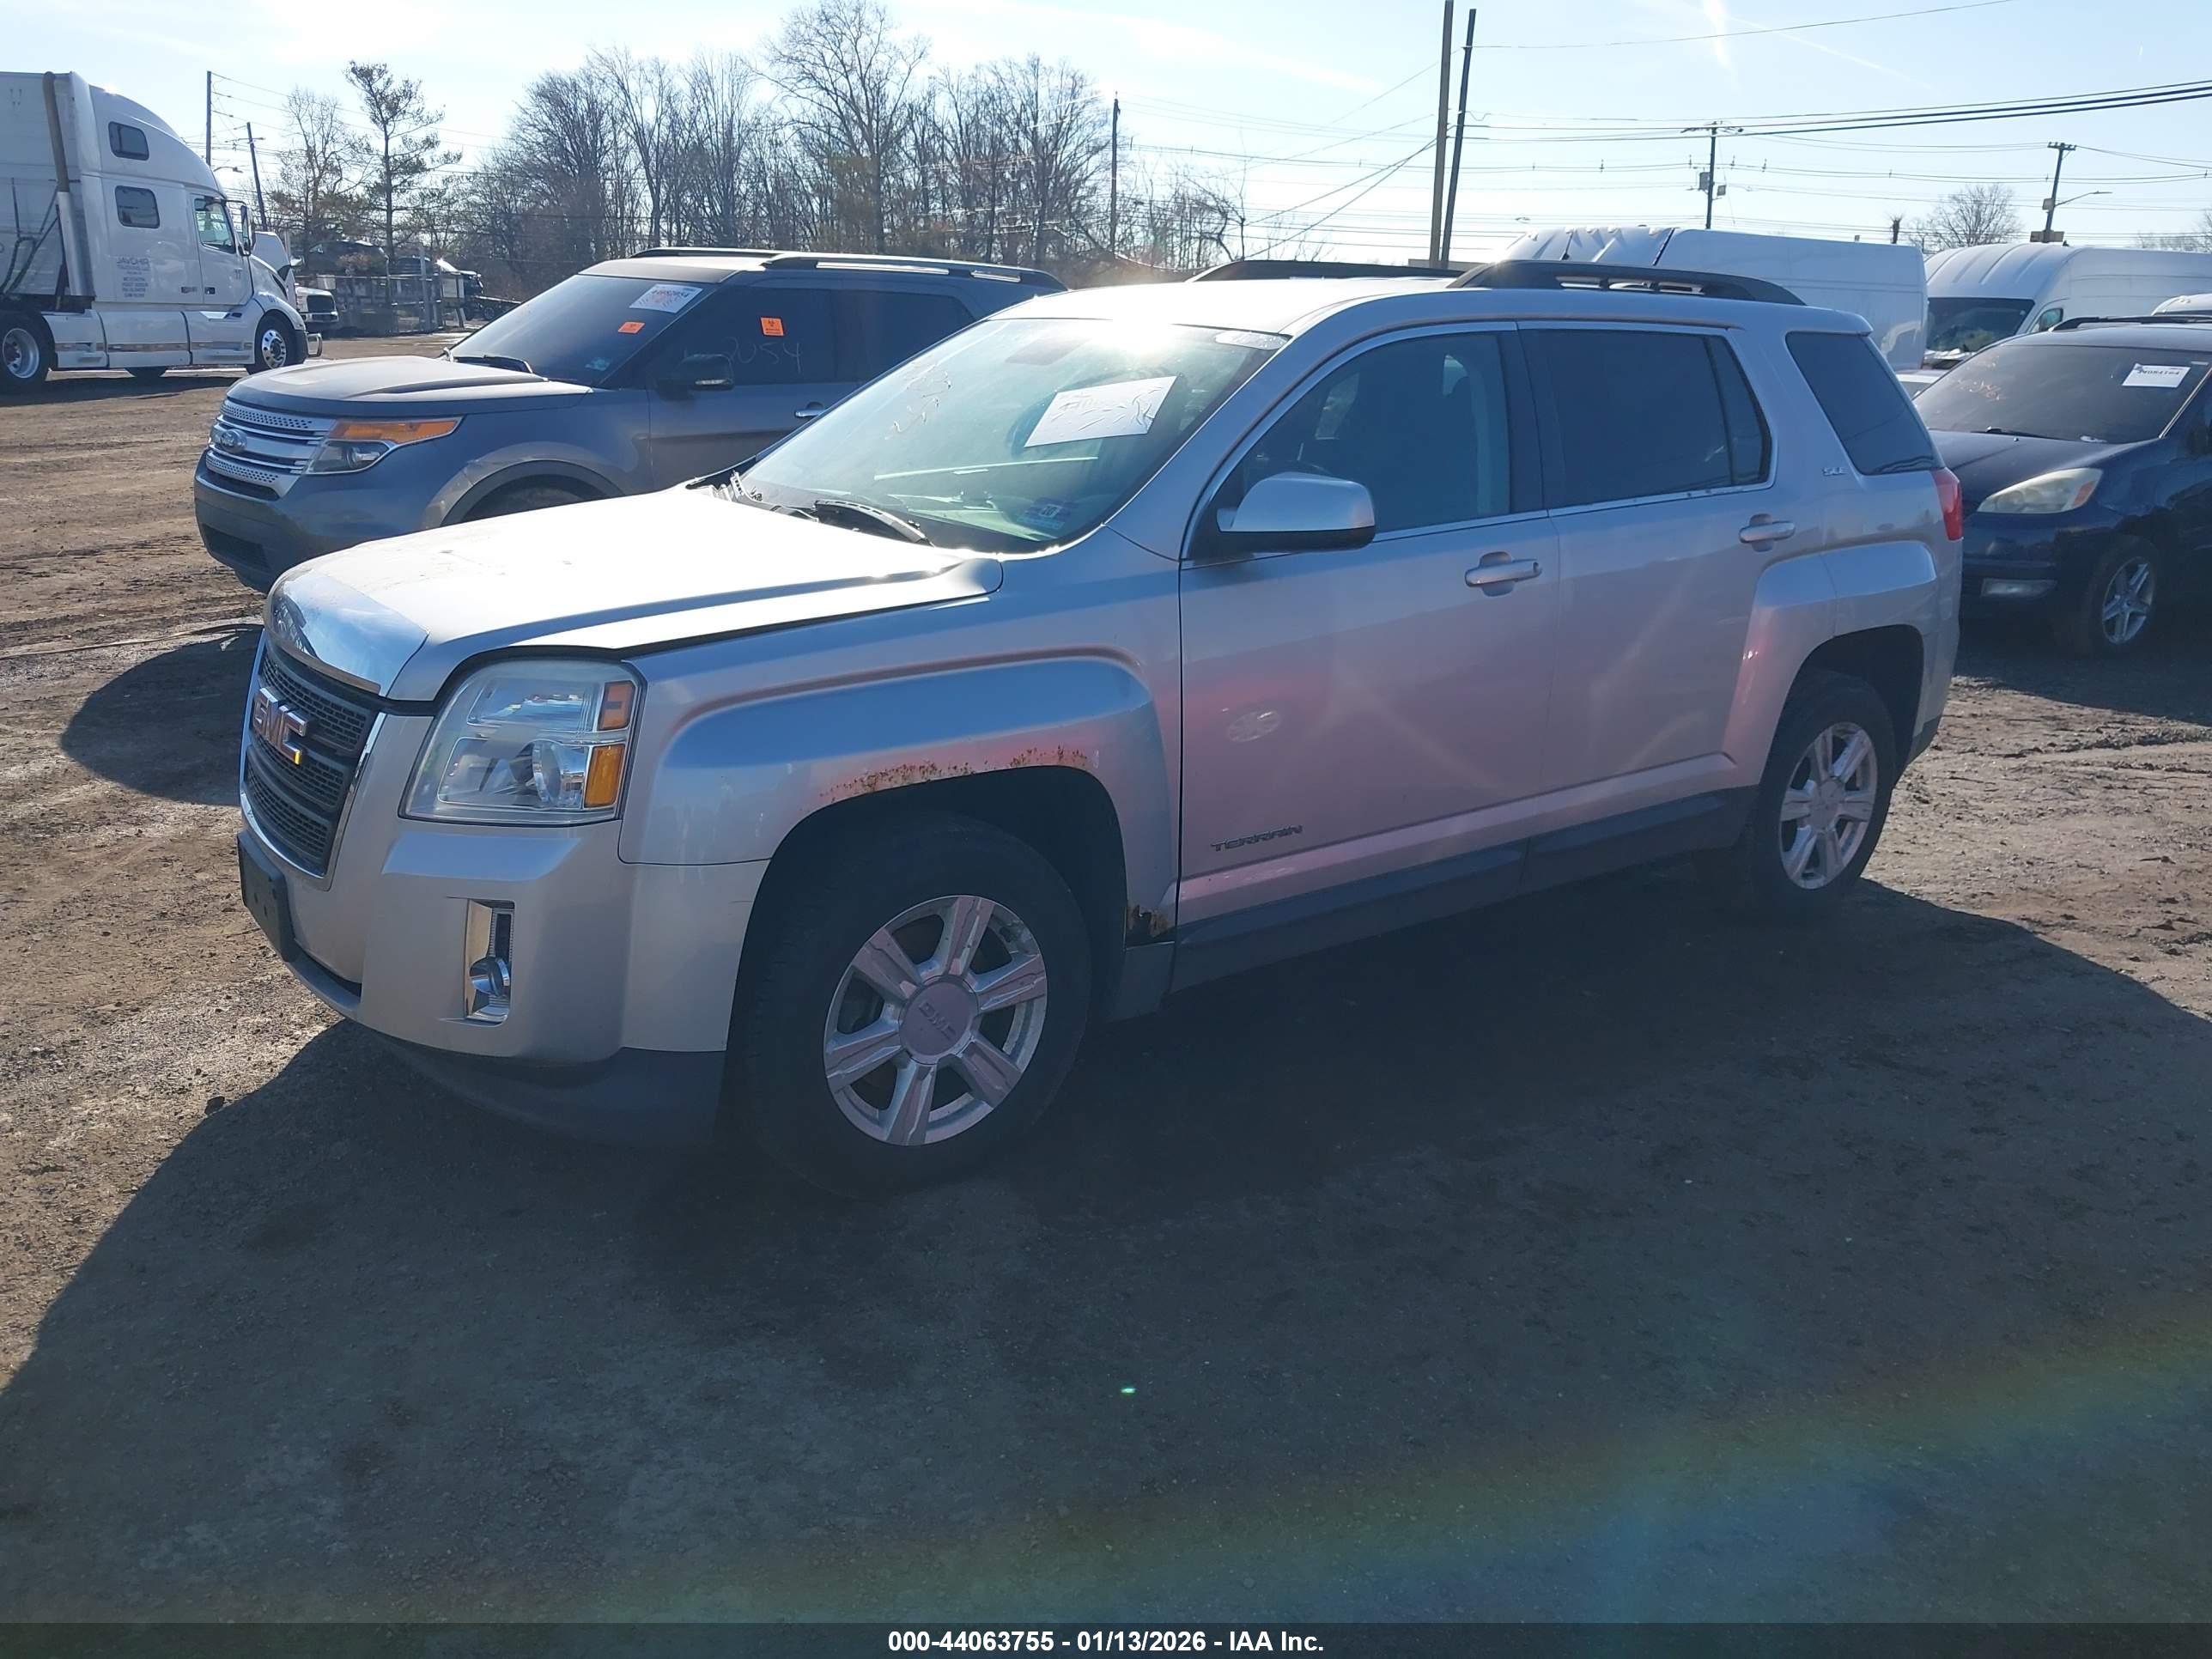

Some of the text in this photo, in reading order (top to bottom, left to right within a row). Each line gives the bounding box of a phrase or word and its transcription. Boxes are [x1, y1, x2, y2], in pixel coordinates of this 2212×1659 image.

[252, 687, 308, 765] GMC
[1210, 824, 1304, 852] TERRAIN
[919, 1001, 956, 1040] GMC
